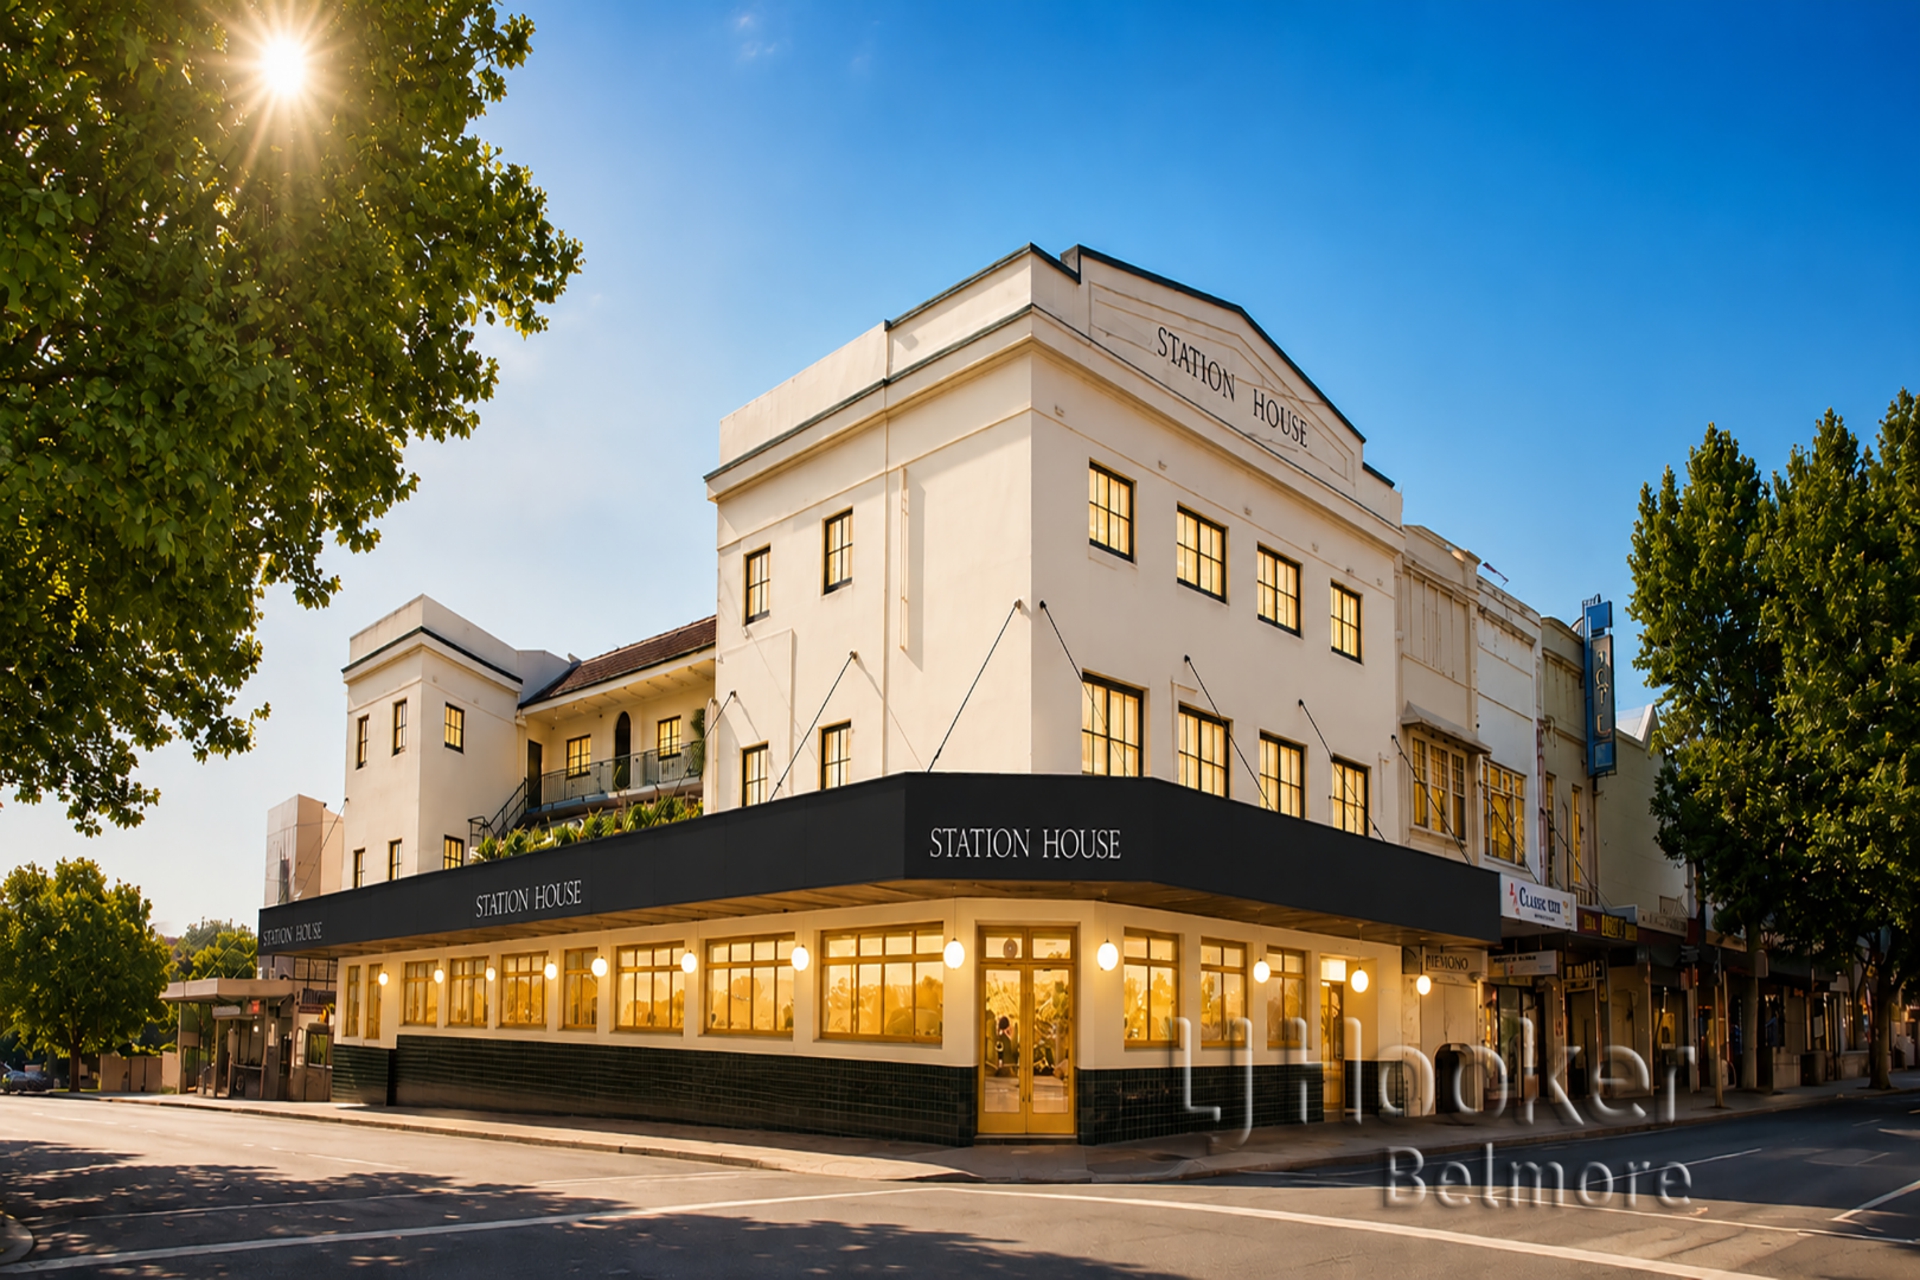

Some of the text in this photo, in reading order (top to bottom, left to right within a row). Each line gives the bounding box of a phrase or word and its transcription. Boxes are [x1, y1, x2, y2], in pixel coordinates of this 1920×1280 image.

[1157, 326, 1308, 449] STATION HOUSE
[929, 827, 1121, 859] STATION HOUSE
[475, 880, 582, 918] STATION HOUSE
[263, 922, 323, 947] STATION HOUSE
